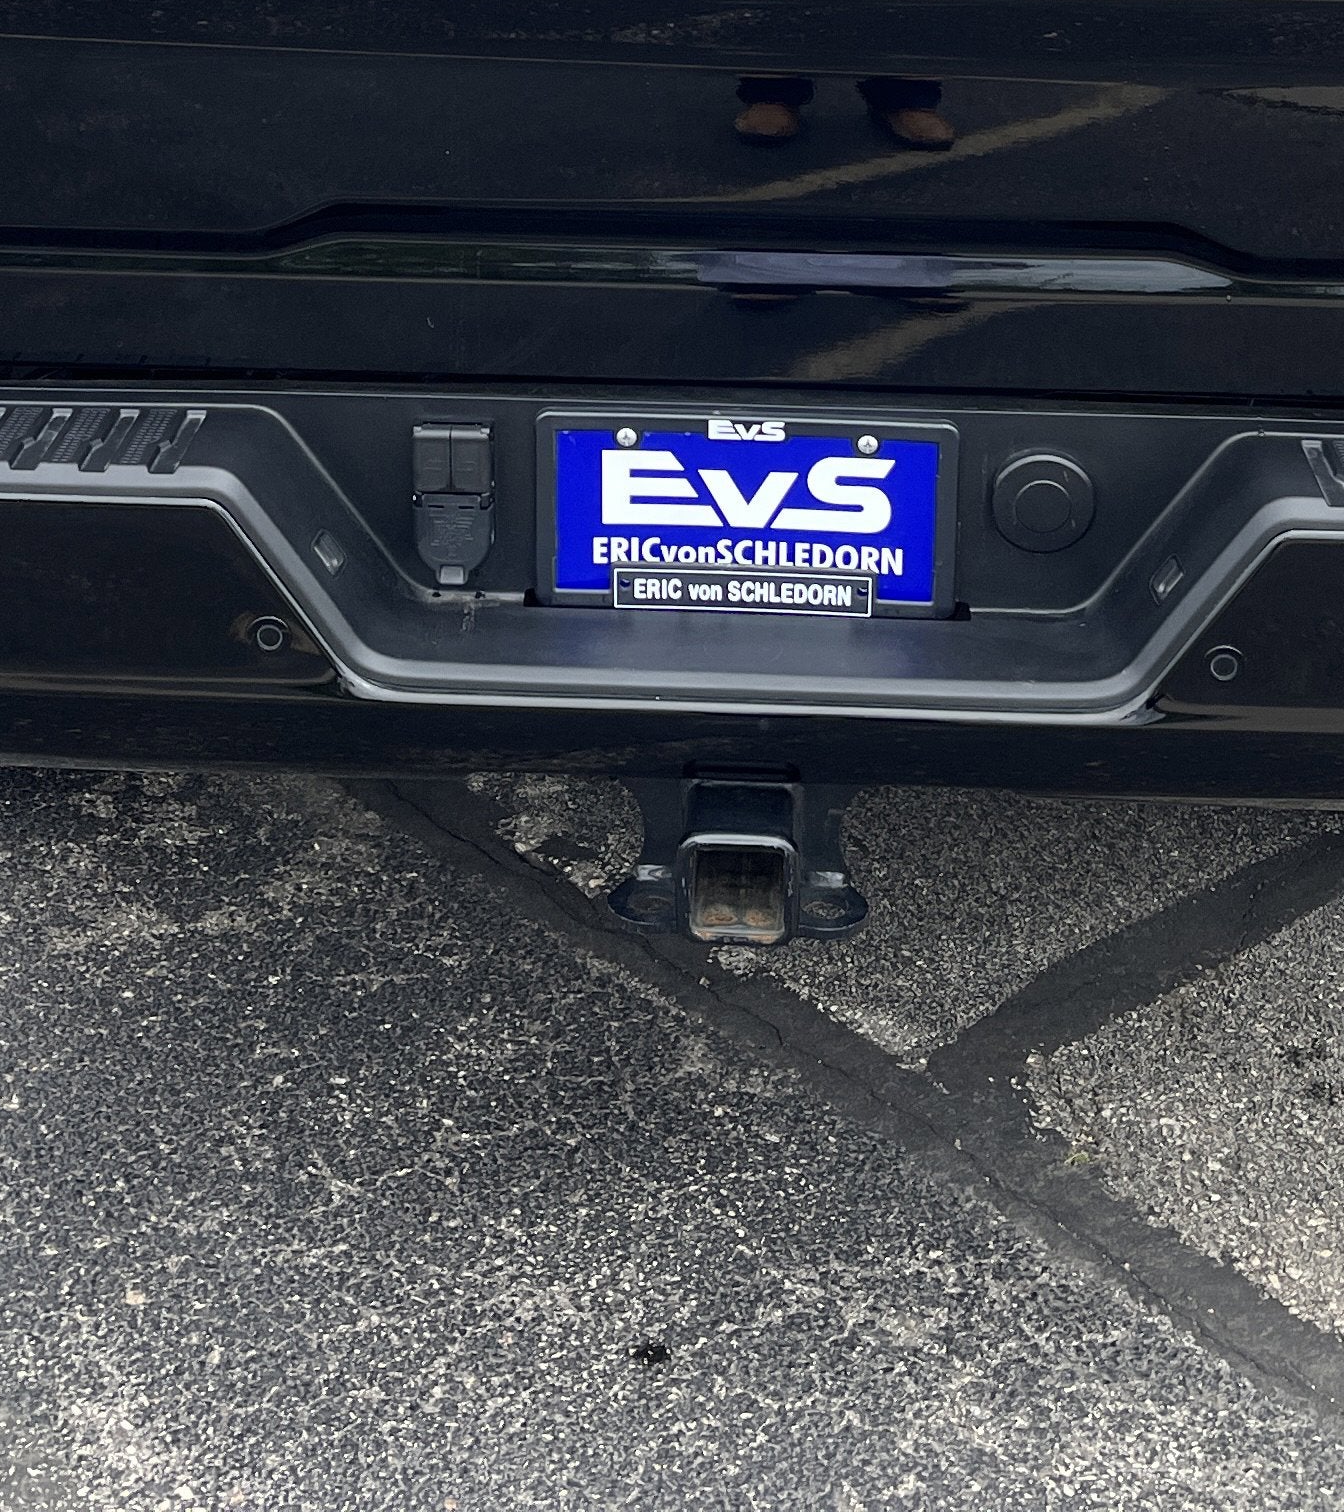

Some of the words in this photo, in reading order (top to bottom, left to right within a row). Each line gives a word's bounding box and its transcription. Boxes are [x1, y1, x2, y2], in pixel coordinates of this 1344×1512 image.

[592, 536, 904, 576] ERICvonSCHLEDORN
[633, 577, 683, 600] ERIC
[687, 582, 723, 601] von
[727, 581, 853, 607] SCHLEDORN
